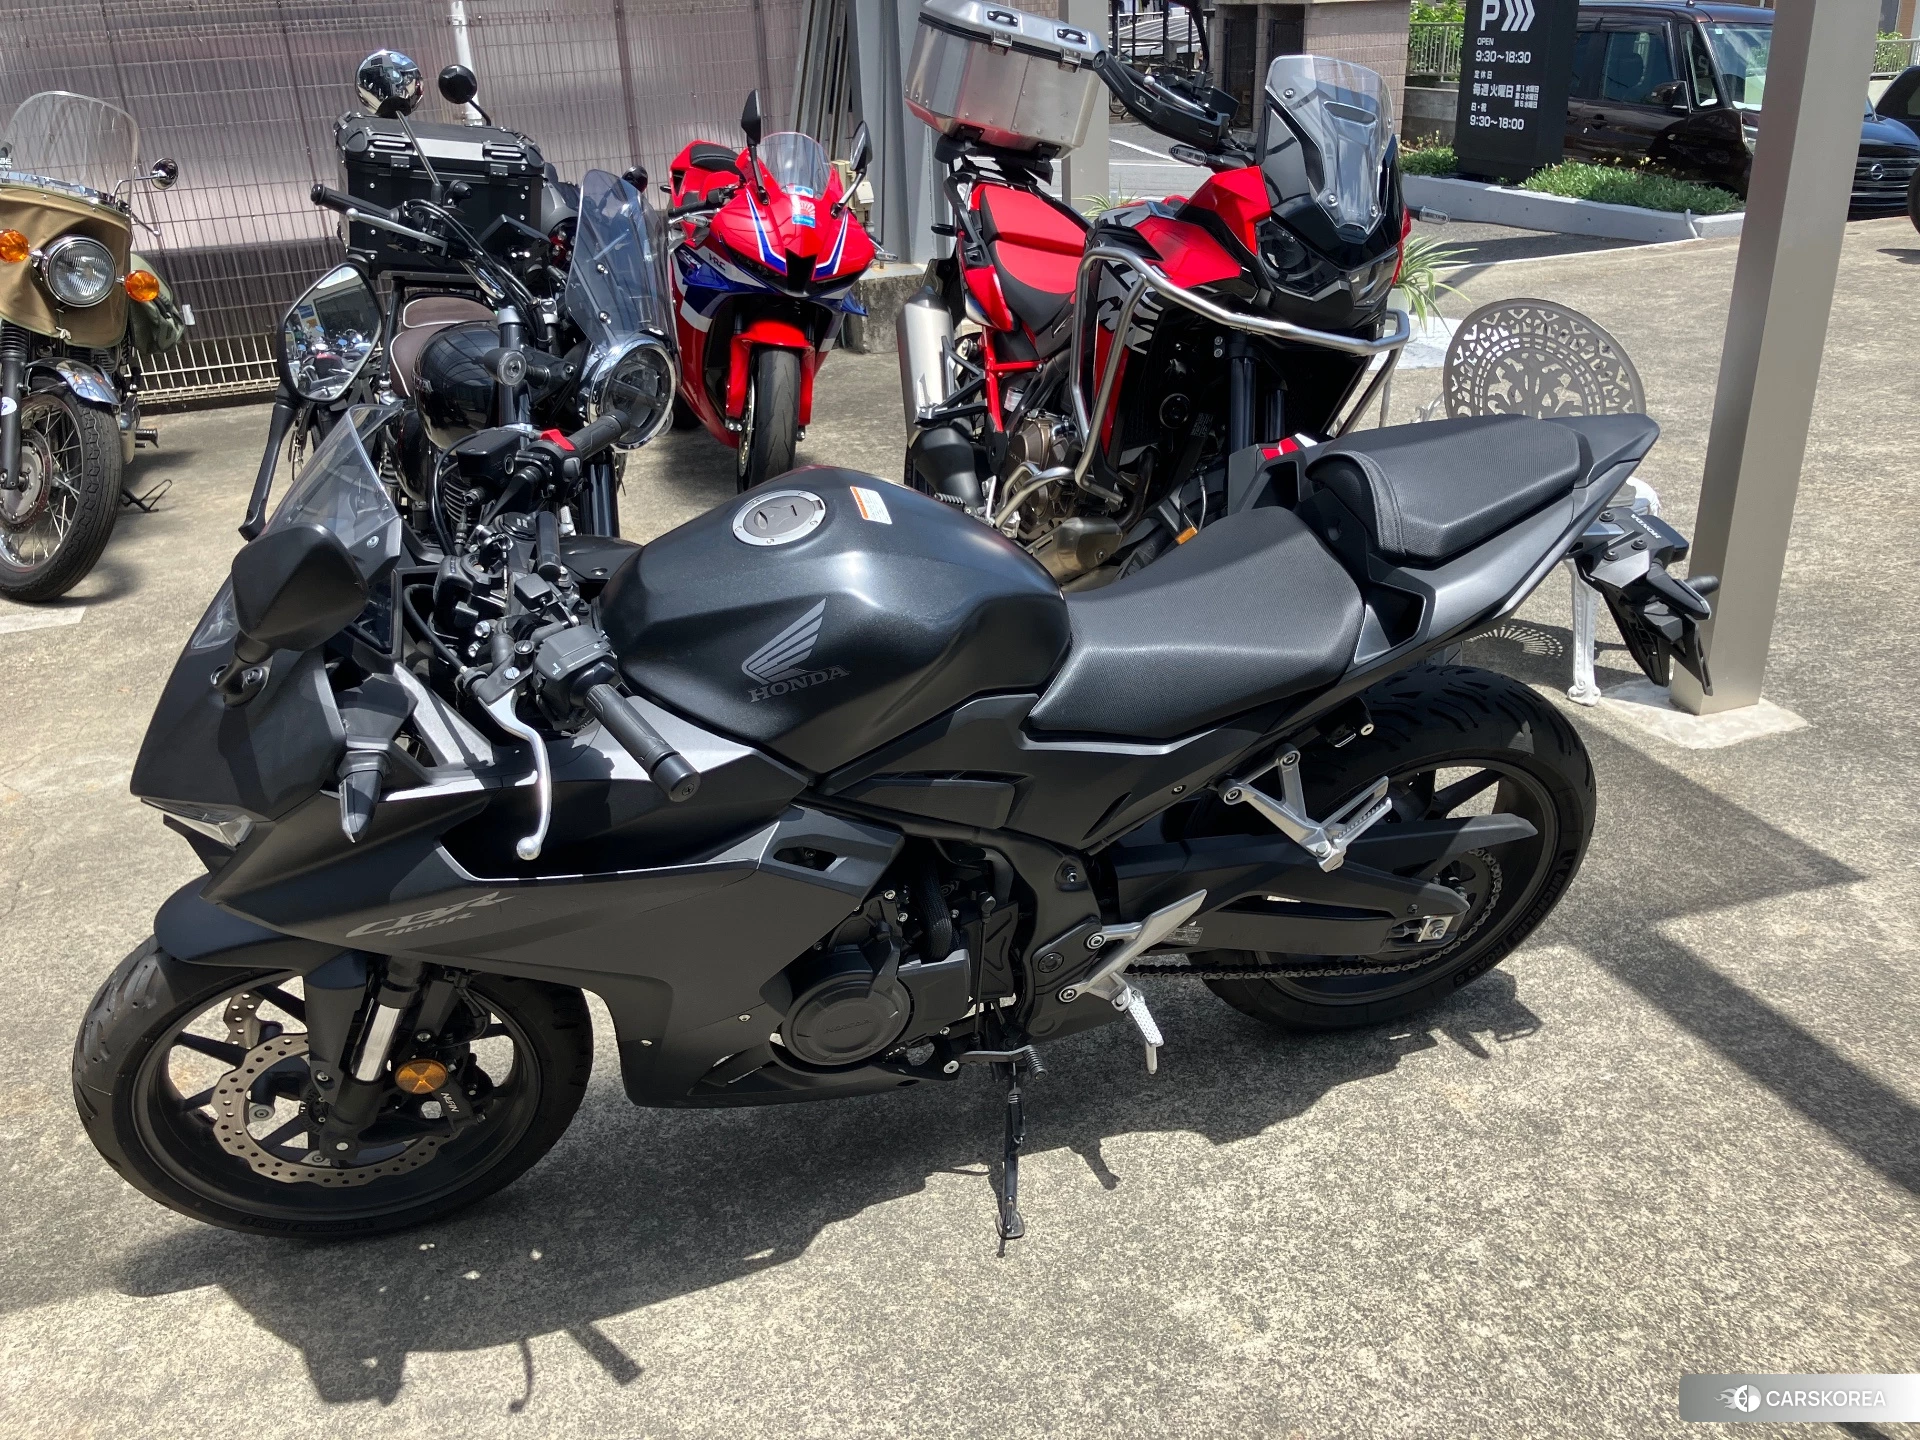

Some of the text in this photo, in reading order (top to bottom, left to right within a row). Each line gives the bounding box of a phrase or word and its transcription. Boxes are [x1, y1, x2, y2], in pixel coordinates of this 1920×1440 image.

[1480, 0, 1500, 31] P
[1477, 37, 1495, 46] OPEN
[1474, 70, 1493, 80] 定休日
[1473, 82, 1514, 98] 毎週火曜日
[708, 252, 726, 271] HRC
[1631, 513, 1662, 538] HONDA
[747, 664, 851, 703] HONDA
[346, 890, 516, 938] CBR
[1512, 872, 1566, 941] MICHELIN
[384, 911, 477, 937] 400R
[1467, 943, 1505, 976] ROAD
